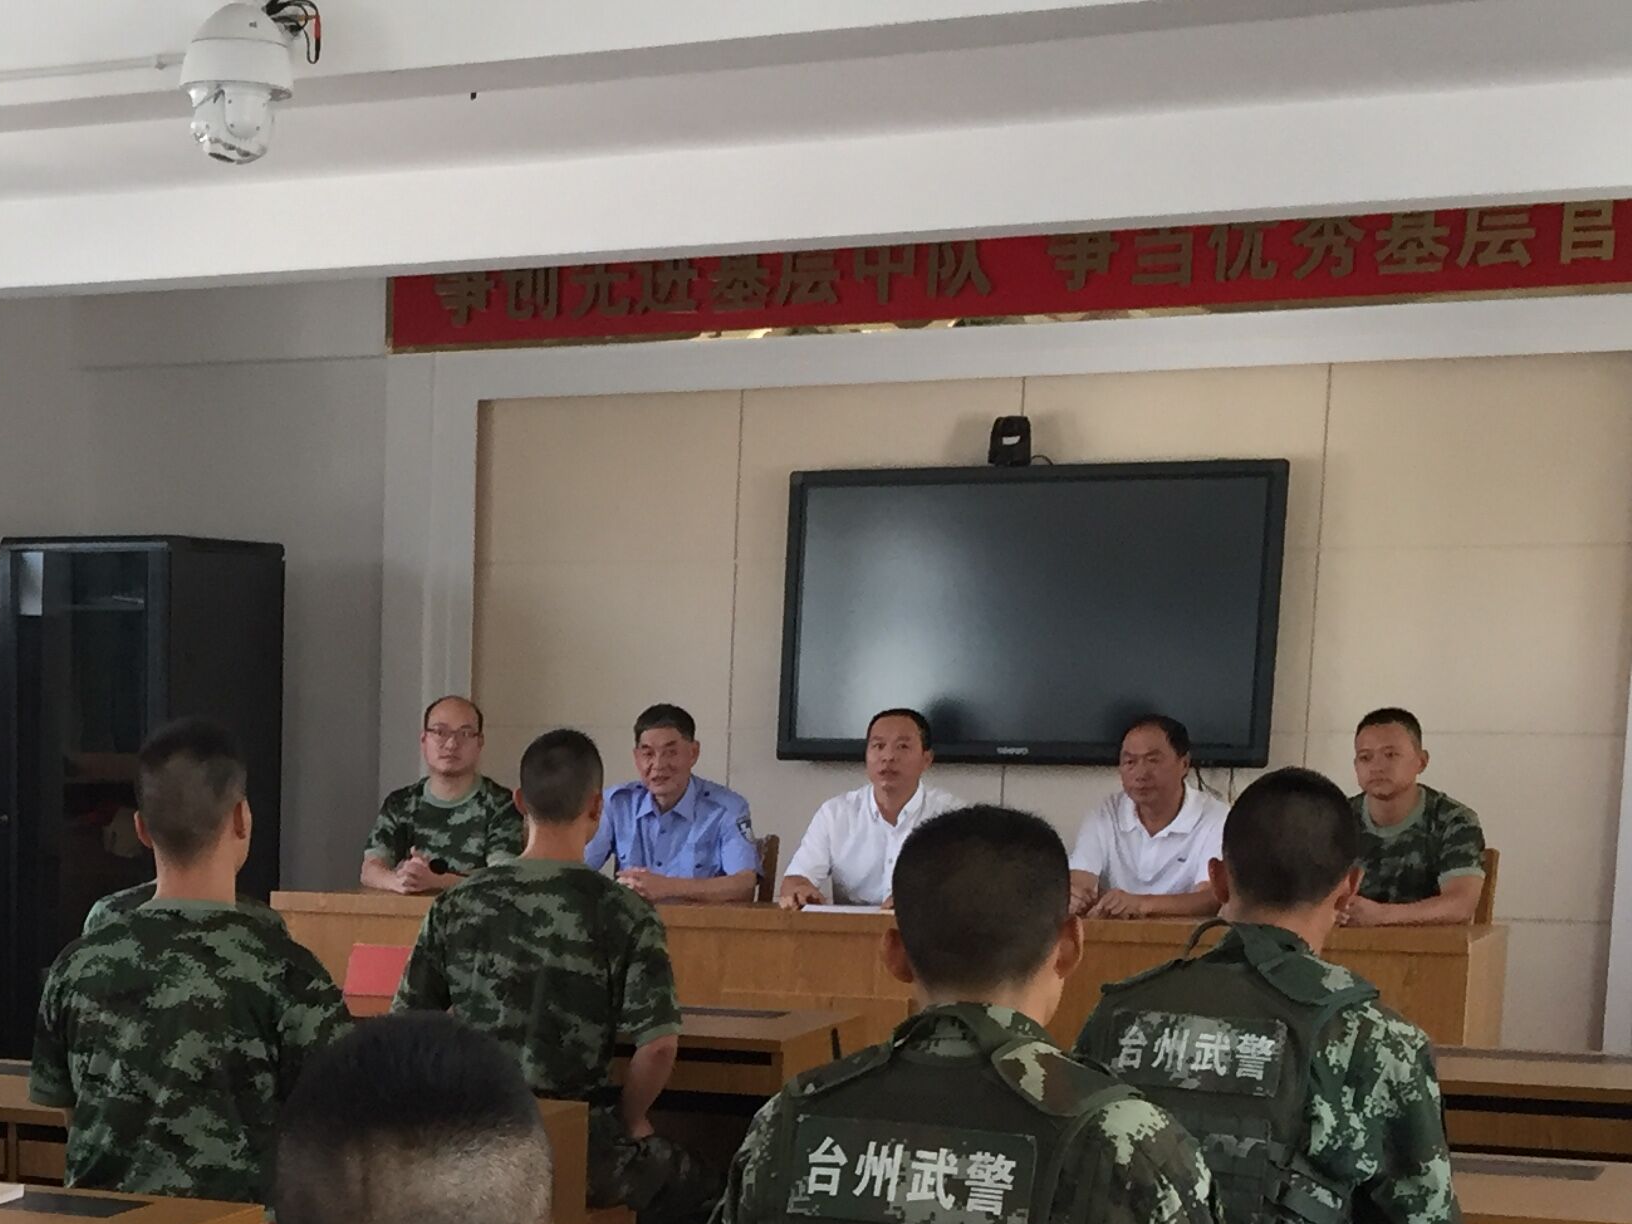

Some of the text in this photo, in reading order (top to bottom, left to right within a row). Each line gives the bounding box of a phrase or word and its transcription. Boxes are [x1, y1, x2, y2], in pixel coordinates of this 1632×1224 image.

[1117, 1025, 1276, 1081] 台州武警
[807, 1136, 1016, 1216] 台州武警
